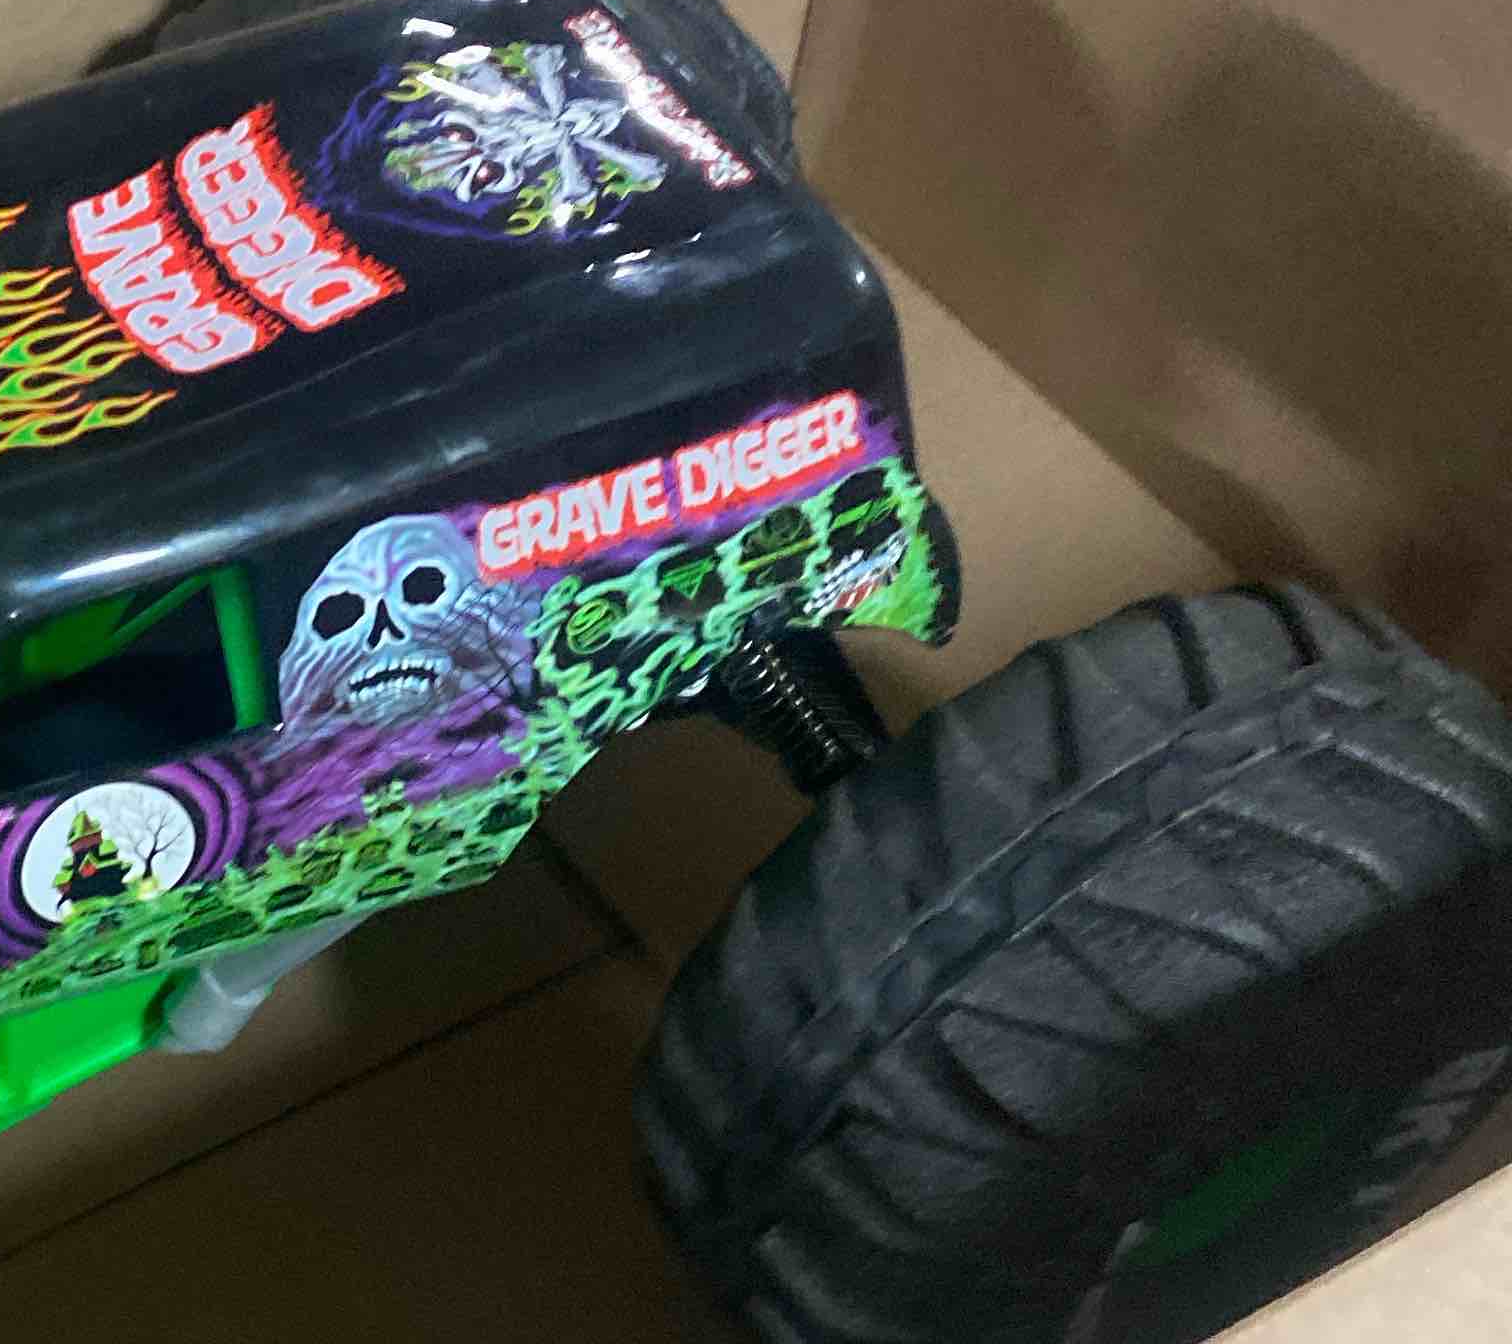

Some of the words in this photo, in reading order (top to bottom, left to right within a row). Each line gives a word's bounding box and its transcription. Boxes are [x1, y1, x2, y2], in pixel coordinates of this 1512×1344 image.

[69, 173, 259, 373] GRAVE
[180, 117, 383, 328] DIGGER
[478, 456, 669, 569] GRAVE
[675, 393, 861, 508] DIGGER
